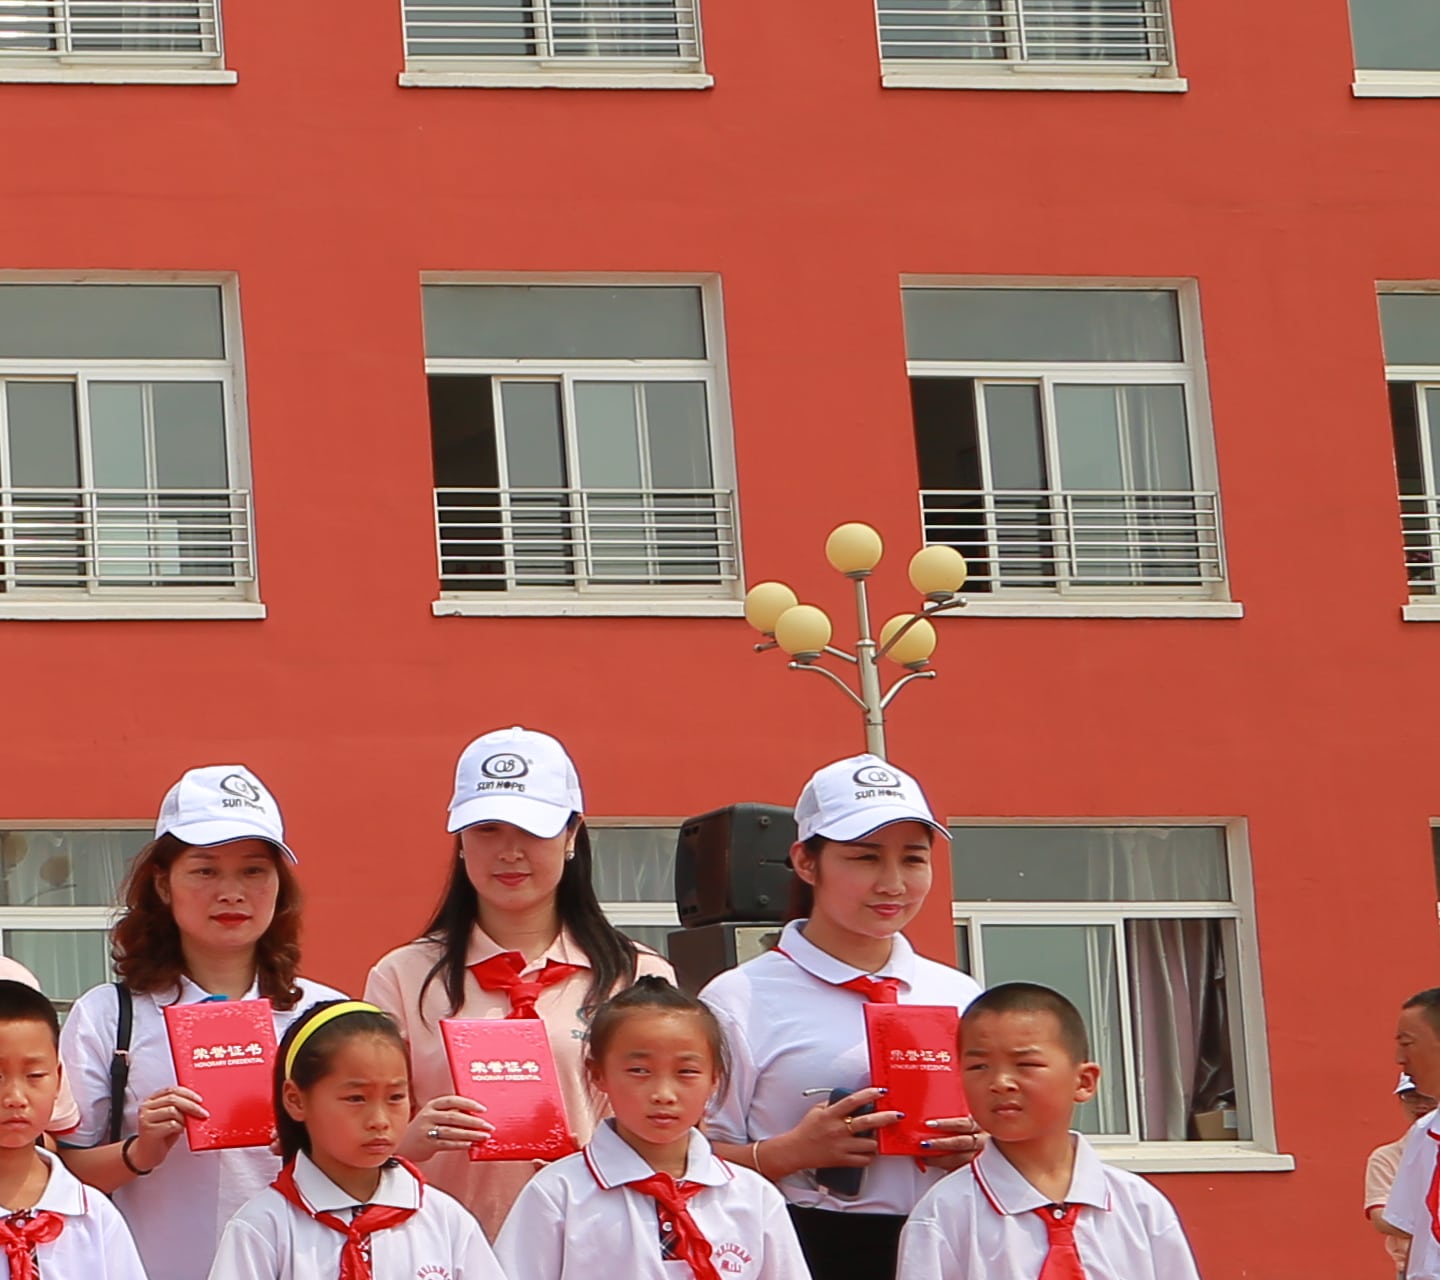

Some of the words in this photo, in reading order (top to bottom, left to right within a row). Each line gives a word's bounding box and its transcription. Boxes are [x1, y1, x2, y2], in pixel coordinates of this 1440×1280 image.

[192, 1042, 264, 1060] 荣誉证书
[470, 1061, 540, 1074] 荣誉证书
